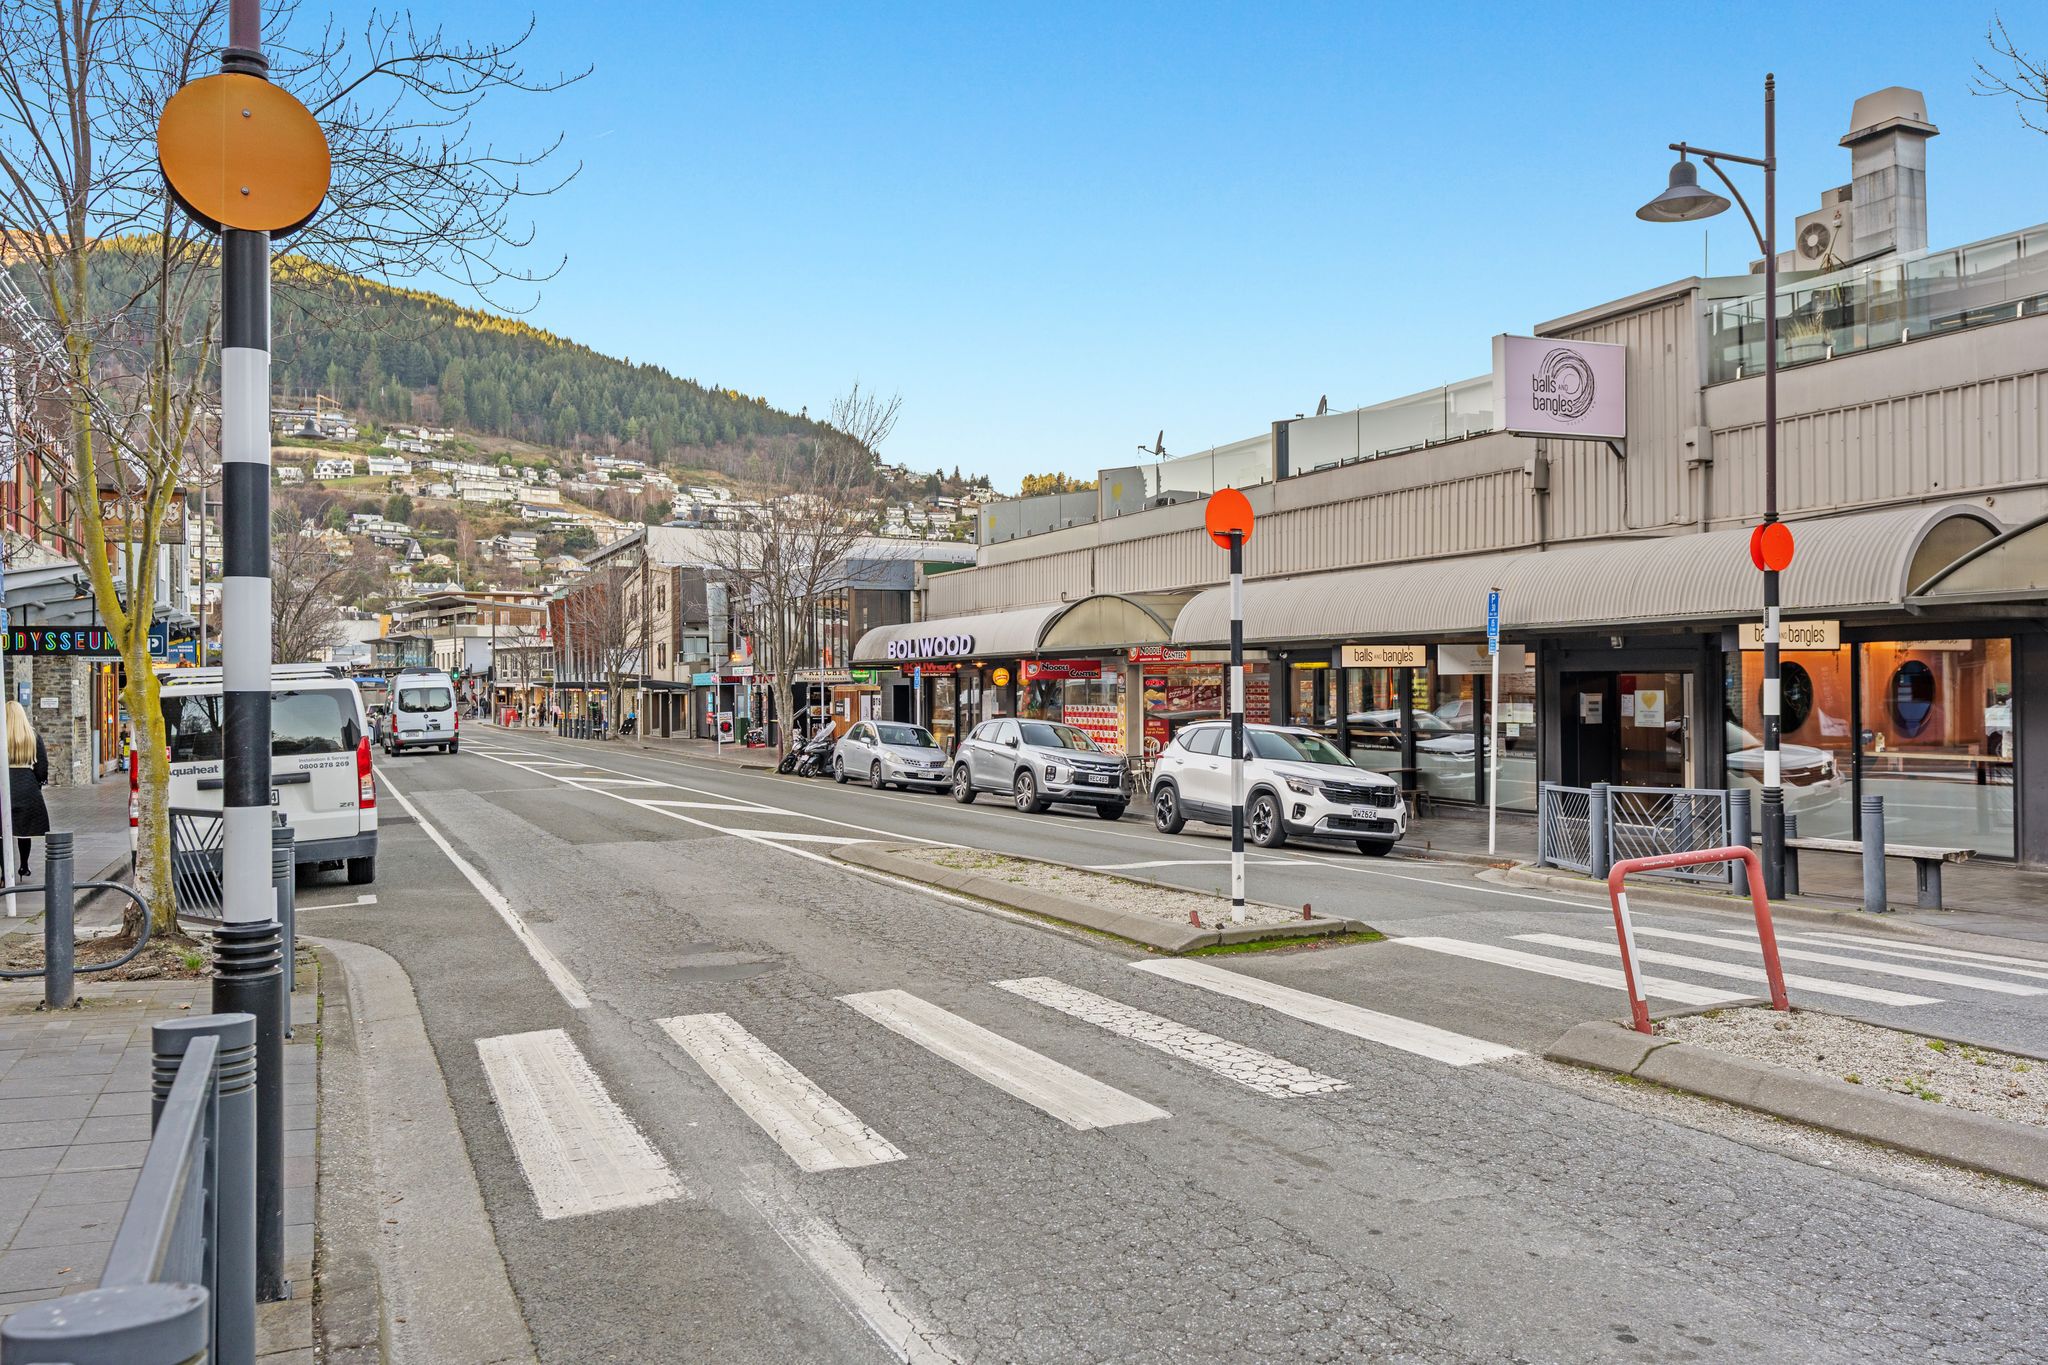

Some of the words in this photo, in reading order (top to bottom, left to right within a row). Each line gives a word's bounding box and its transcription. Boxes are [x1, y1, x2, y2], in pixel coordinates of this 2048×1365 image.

[1533, 374, 1556, 393] balls
[1533, 393, 1573, 415] bangles
[1789, 625, 1825, 646] bangles
[888, 634, 973, 659] BOLIWOOD
[1162, 648, 1187, 660] CANTEEN
[1354, 648, 1373, 662] balls
[1383, 648, 1414, 665] bangles
[1041, 662, 1069, 671] NOODLE
[1069, 668, 1099, 677] CANTEEN
